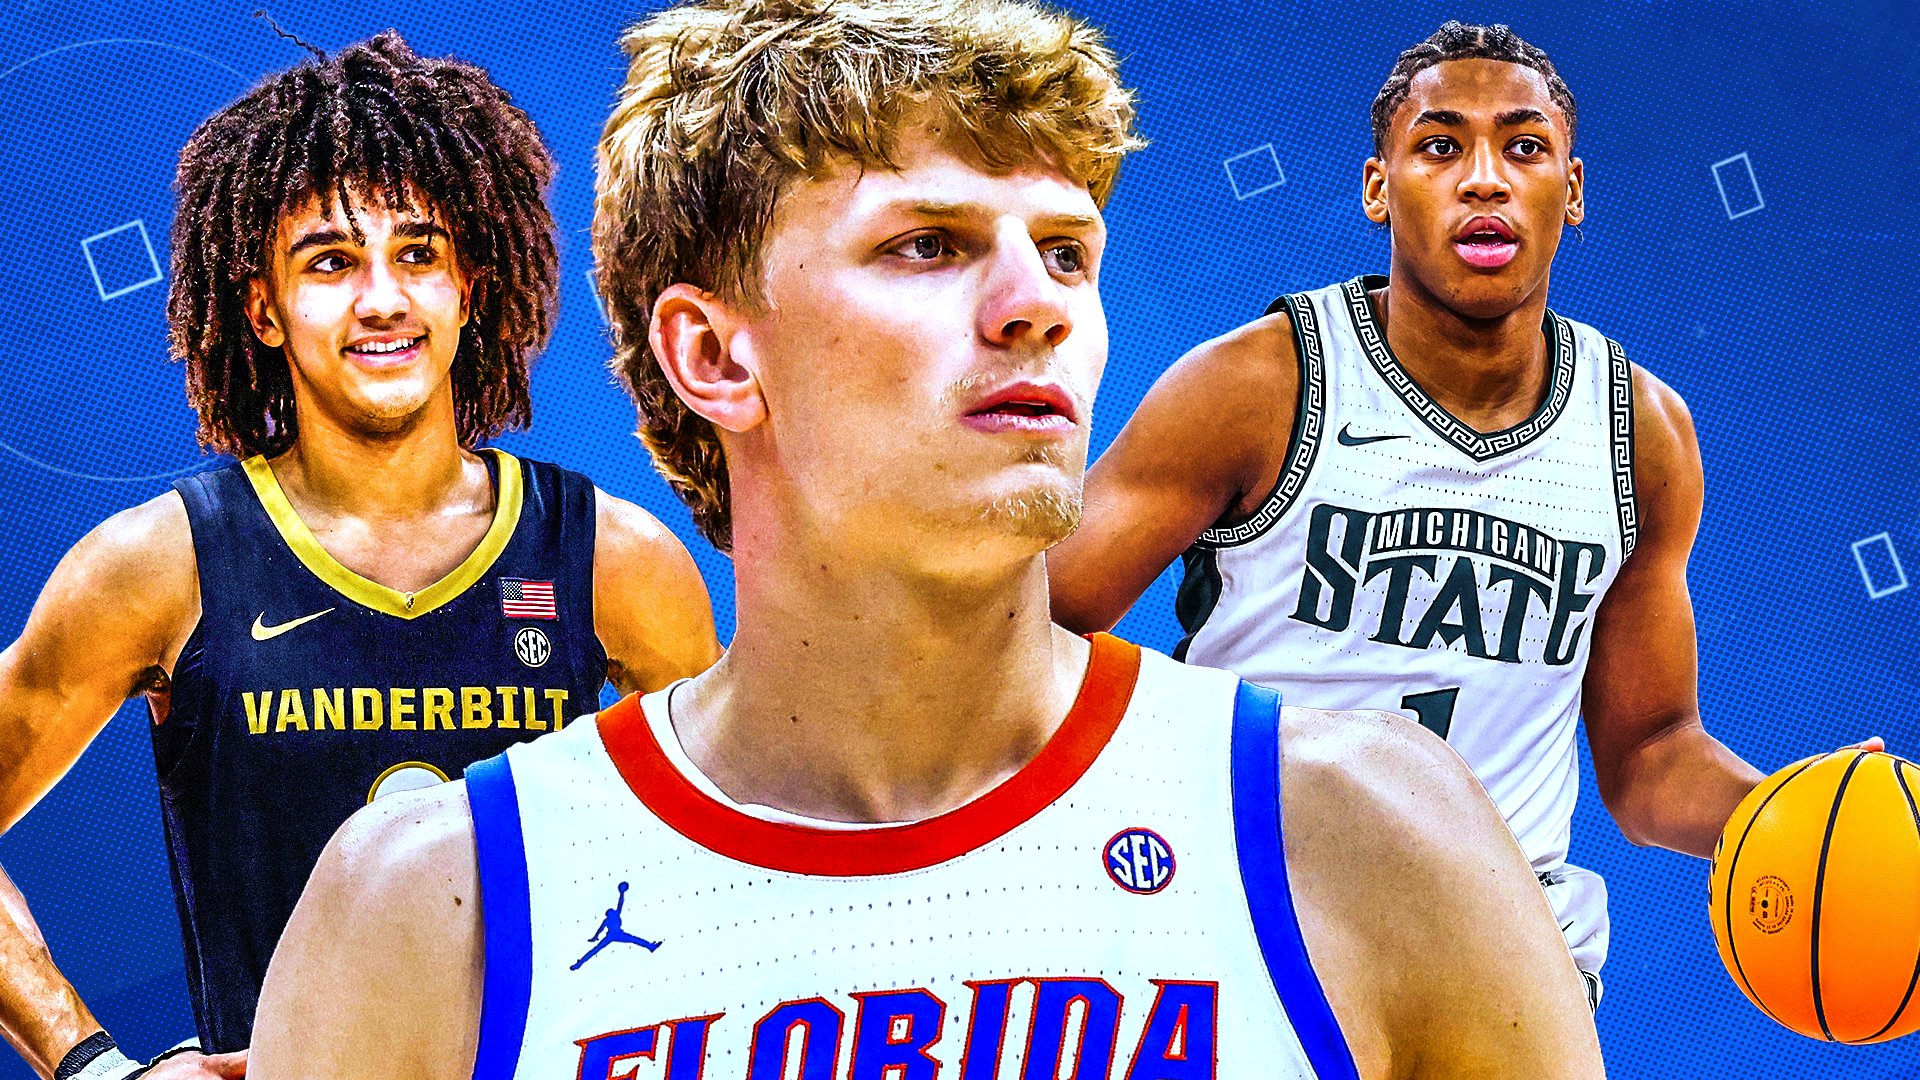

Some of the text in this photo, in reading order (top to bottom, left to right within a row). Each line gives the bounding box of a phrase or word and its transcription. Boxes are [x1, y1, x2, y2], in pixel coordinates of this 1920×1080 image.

[1376, 510, 1554, 574] MICHIGAN
[1288, 503, 1606, 666] STATE
[517, 630, 548, 664] SEC
[241, 686, 569, 735] VANDERBILT
[1109, 834, 1169, 889] SEC
